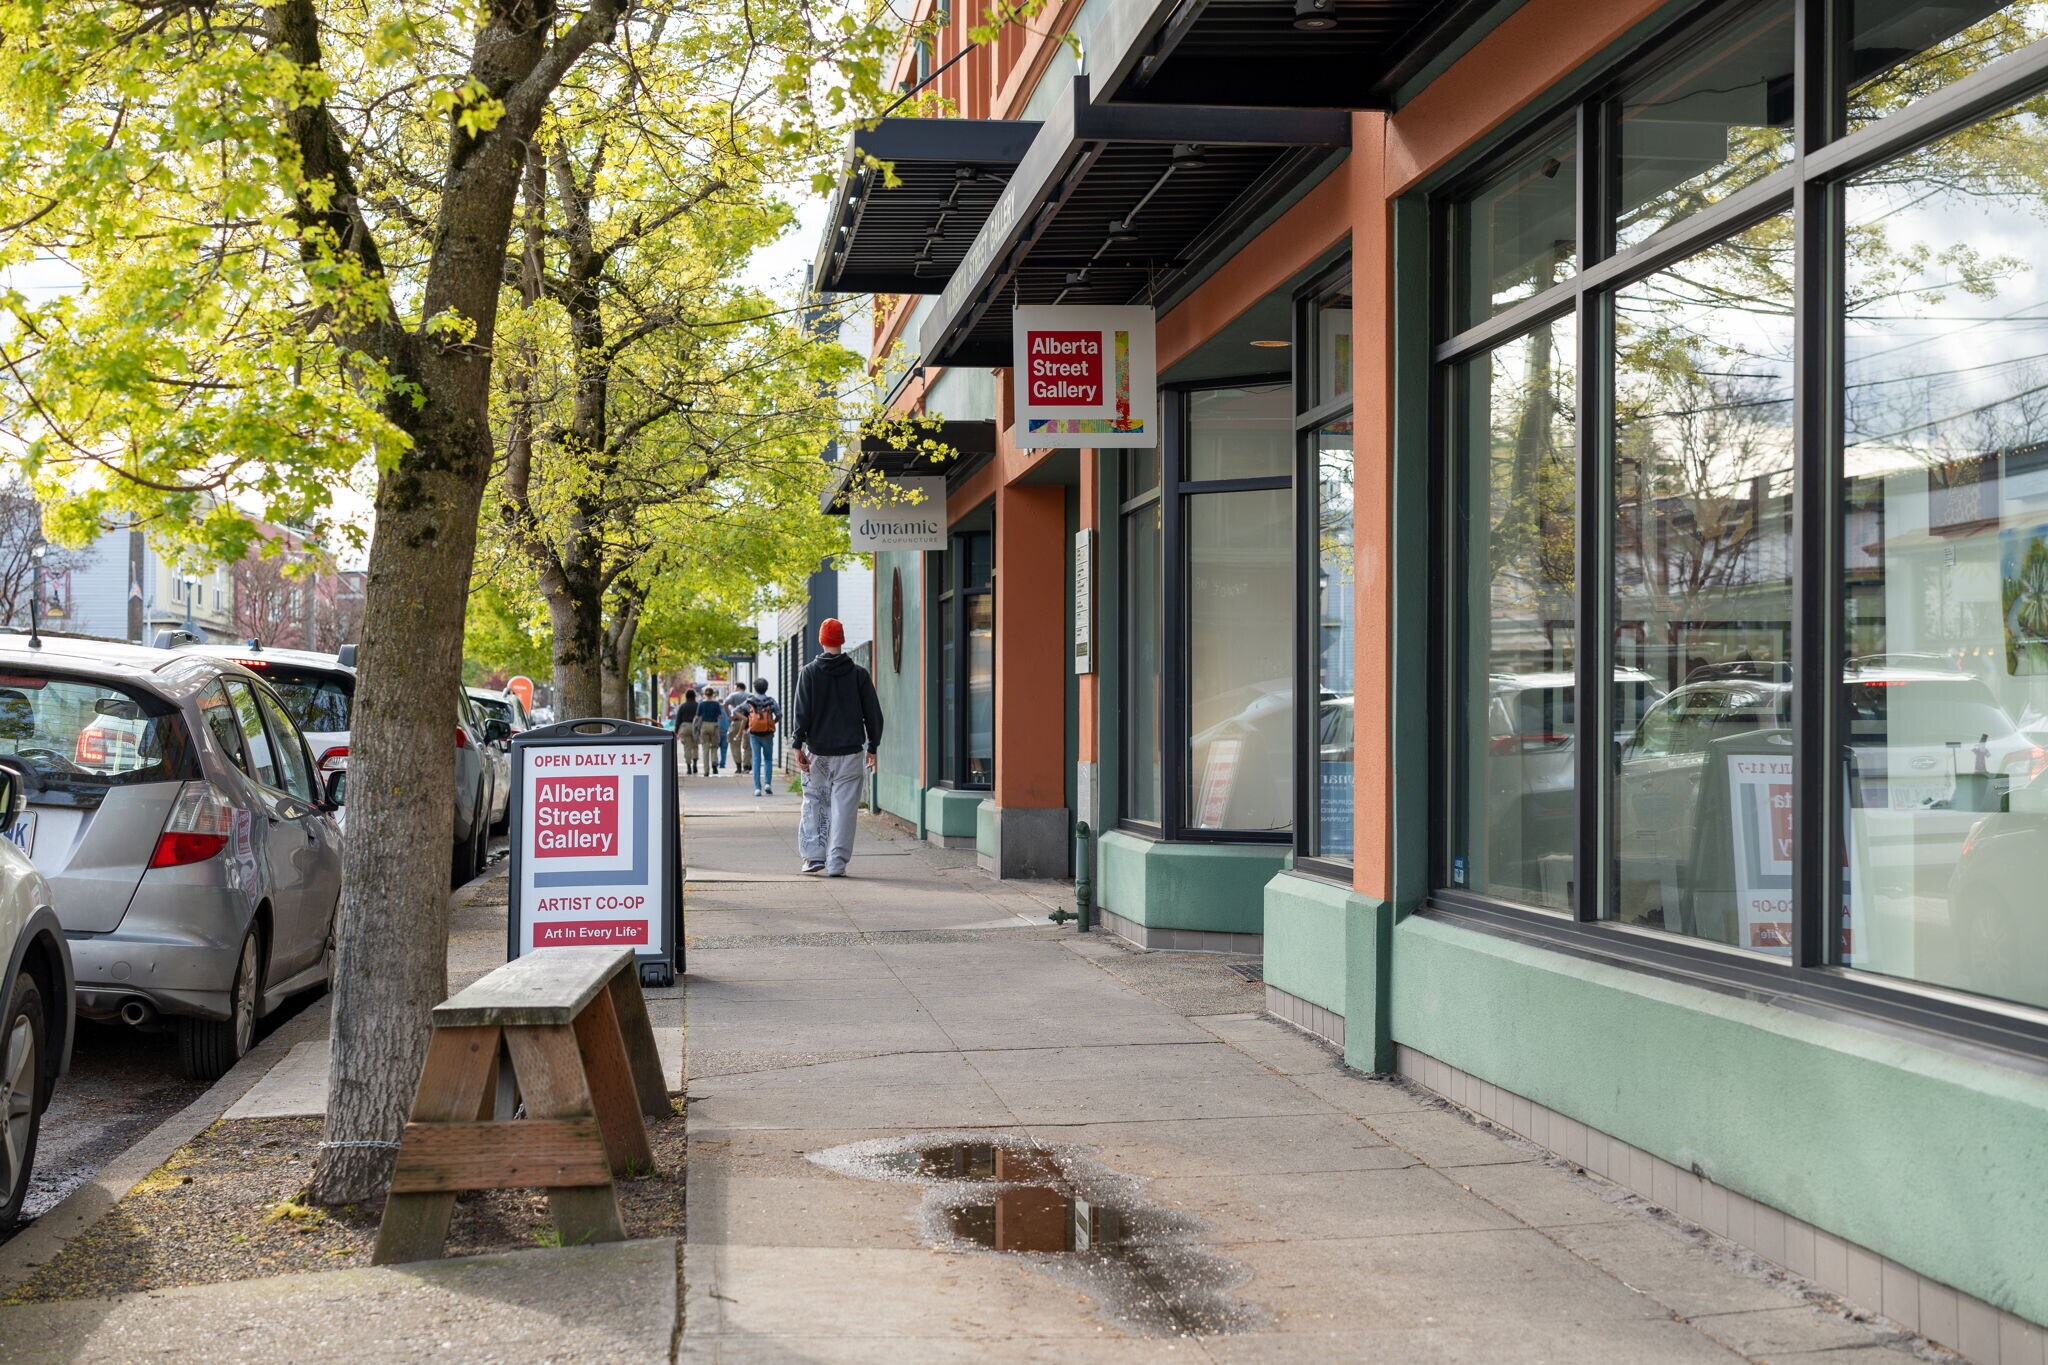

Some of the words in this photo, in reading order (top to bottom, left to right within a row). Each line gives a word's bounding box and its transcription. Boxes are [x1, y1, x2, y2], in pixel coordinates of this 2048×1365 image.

[989, 185, 1016, 252] GALLERY
[1032, 337, 1098, 354] Alberta
[1033, 359, 1089, 377] Street
[1033, 381, 1097, 402] Gallery
[860, 519, 938, 540] dynamic
[534, 755, 571, 768] OPEN
[575, 754, 617, 766] DAILY
[621, 753, 651, 765] 11-7
[538, 784, 615, 803] Alberta
[538, 807, 601, 826] Street
[538, 829, 613, 853] Gallery
[537, 897, 592, 912] ARTIST
[595, 896, 645, 910] CO-OP
[544, 928, 563, 939] Art
[565, 928, 576, 938] In
[579, 927, 612, 940] Every
